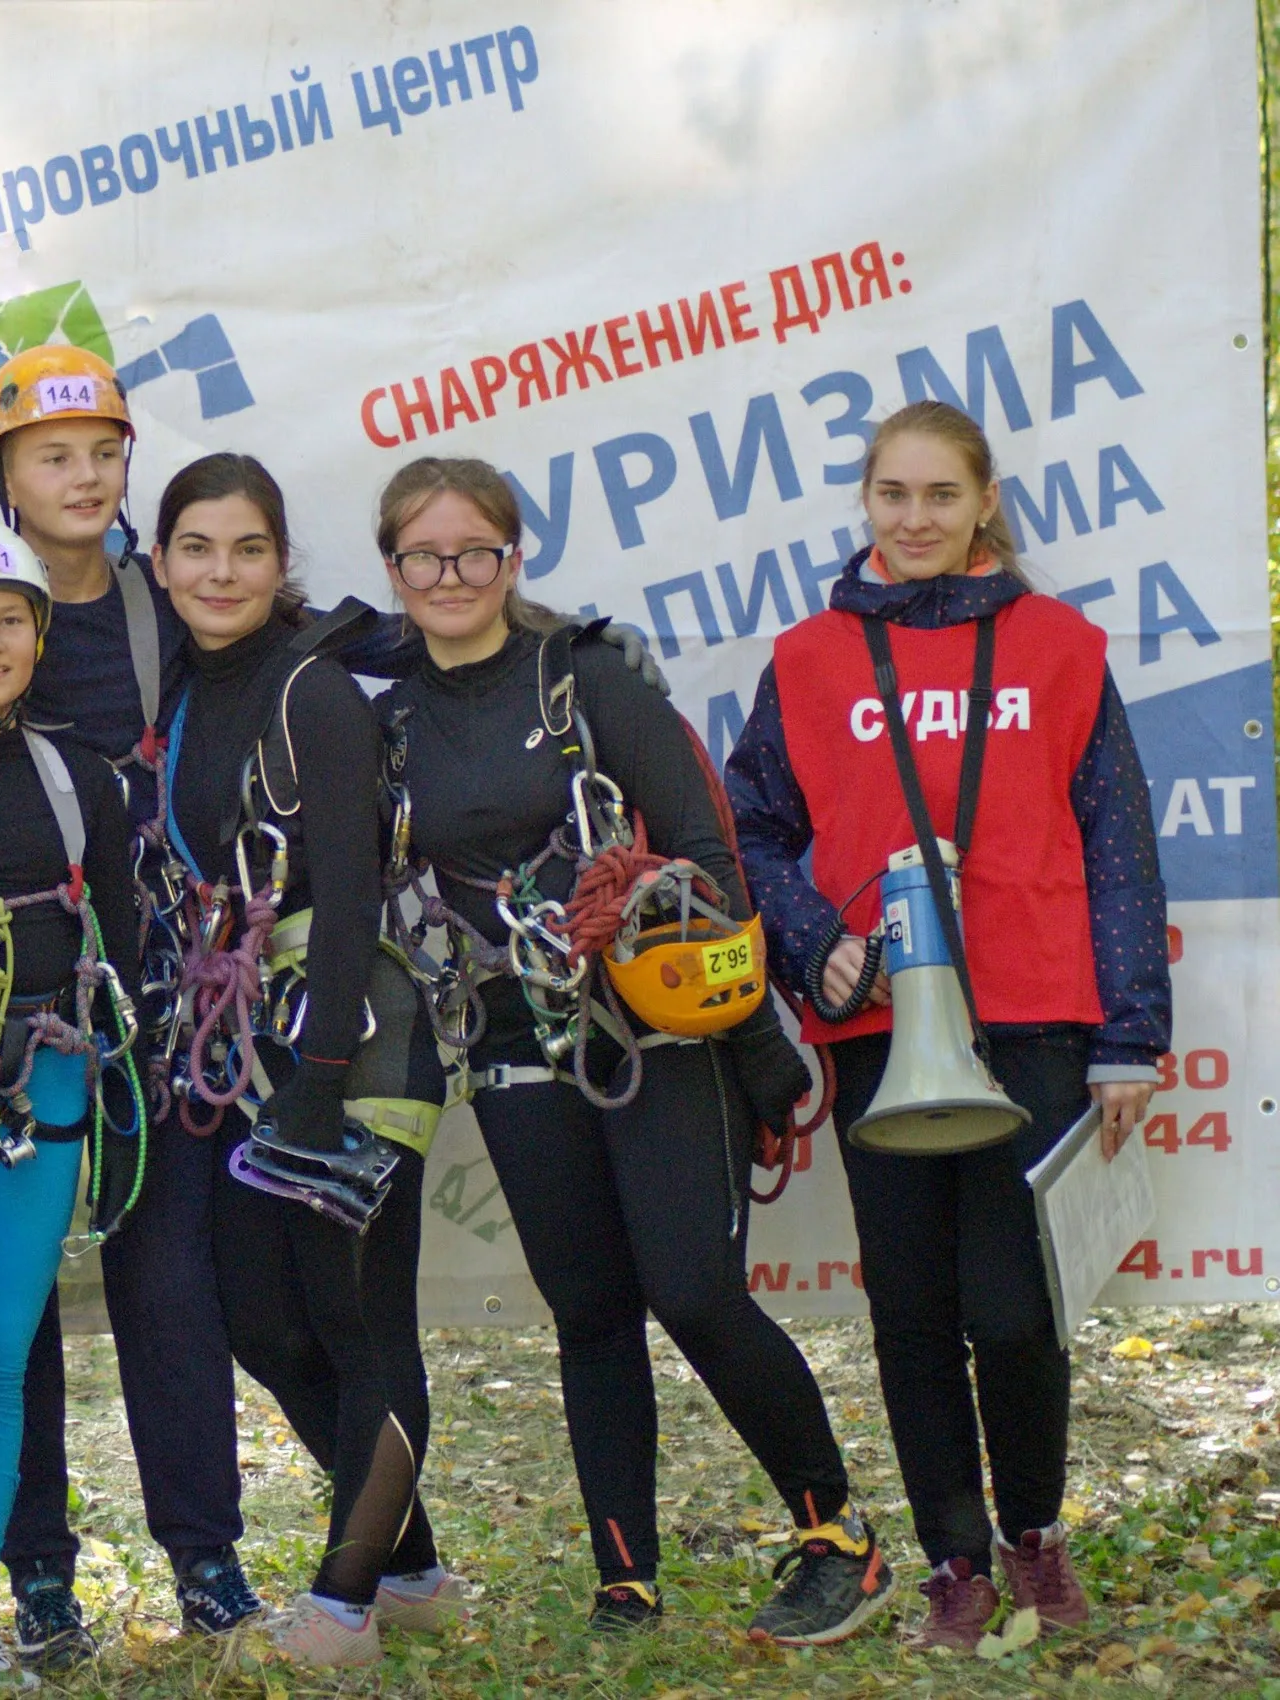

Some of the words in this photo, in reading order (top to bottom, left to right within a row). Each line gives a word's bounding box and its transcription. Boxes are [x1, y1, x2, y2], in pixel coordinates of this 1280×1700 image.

[350, 24, 539, 137] центр
[47, 385, 90, 404] 14.4
[361, 281, 761, 449] СНАРЯЖЕНИЕ
[768, 241, 914, 344] ДЛЯ:
[501, 298, 1145, 581] УРИЗМА
[710, 944, 747, 973] 56.2
